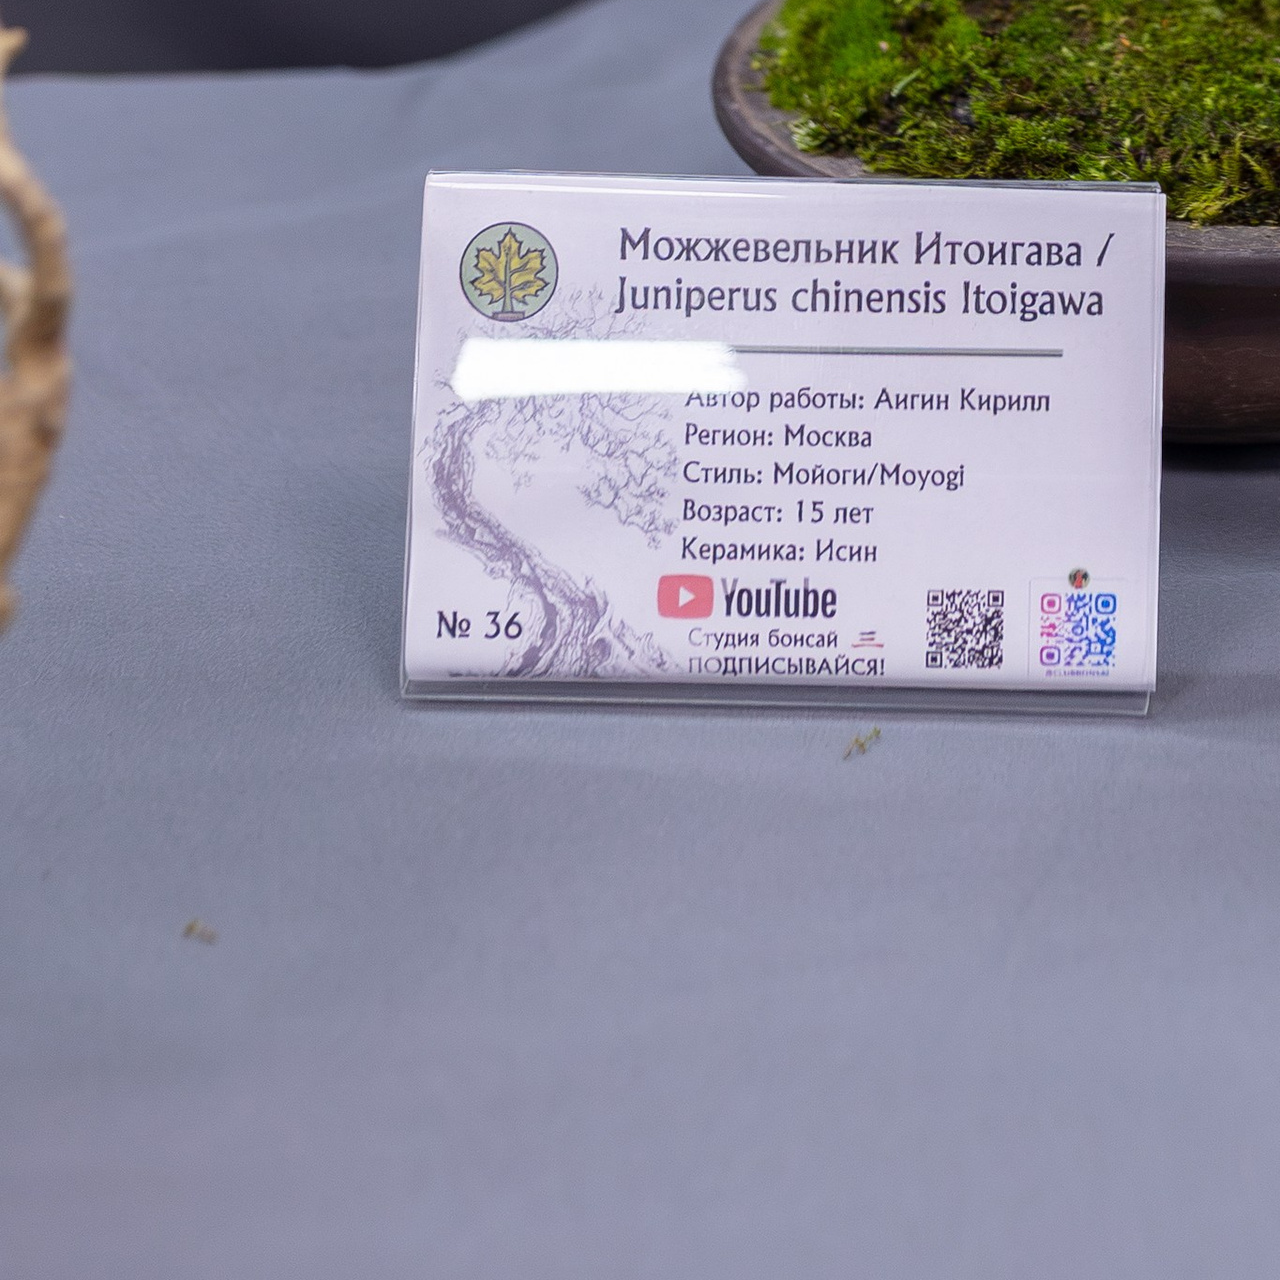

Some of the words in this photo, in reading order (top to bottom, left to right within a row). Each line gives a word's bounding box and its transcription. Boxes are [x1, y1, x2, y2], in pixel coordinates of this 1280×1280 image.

[619, 227, 899, 264] Можжевельник
[914, 231, 1082, 267] Итоигава
[614, 276, 778, 318] Juniperus
[791, 278, 946, 315] chinensis
[961, 280, 1104, 323] Itoigawa
[684, 388, 760, 413] Автор
[769, 387, 865, 413] работы:
[873, 387, 950, 411] Аигин
[959, 387, 1051, 416] Кирилл
[684, 422, 774, 447] Регион:
[784, 423, 873, 448] Москва
[682, 460, 764, 485] Стиль:
[772, 461, 966, 492] Мойоги/Moyogi
[682, 498, 783, 527] Возраст:
[796, 499, 825, 524] 15
[832, 506, 875, 525] лет
[680, 536, 805, 565] Керамика:
[815, 538, 878, 563] Исин
[720, 577, 838, 619] YouTube
[436, 610, 472, 639] №
[483, 610, 523, 640] 36
[688, 627, 760, 651] Студия
[767, 628, 839, 649] бонсай
[688, 654, 886, 677] ПОДПИСЫВАЙСЯ!
